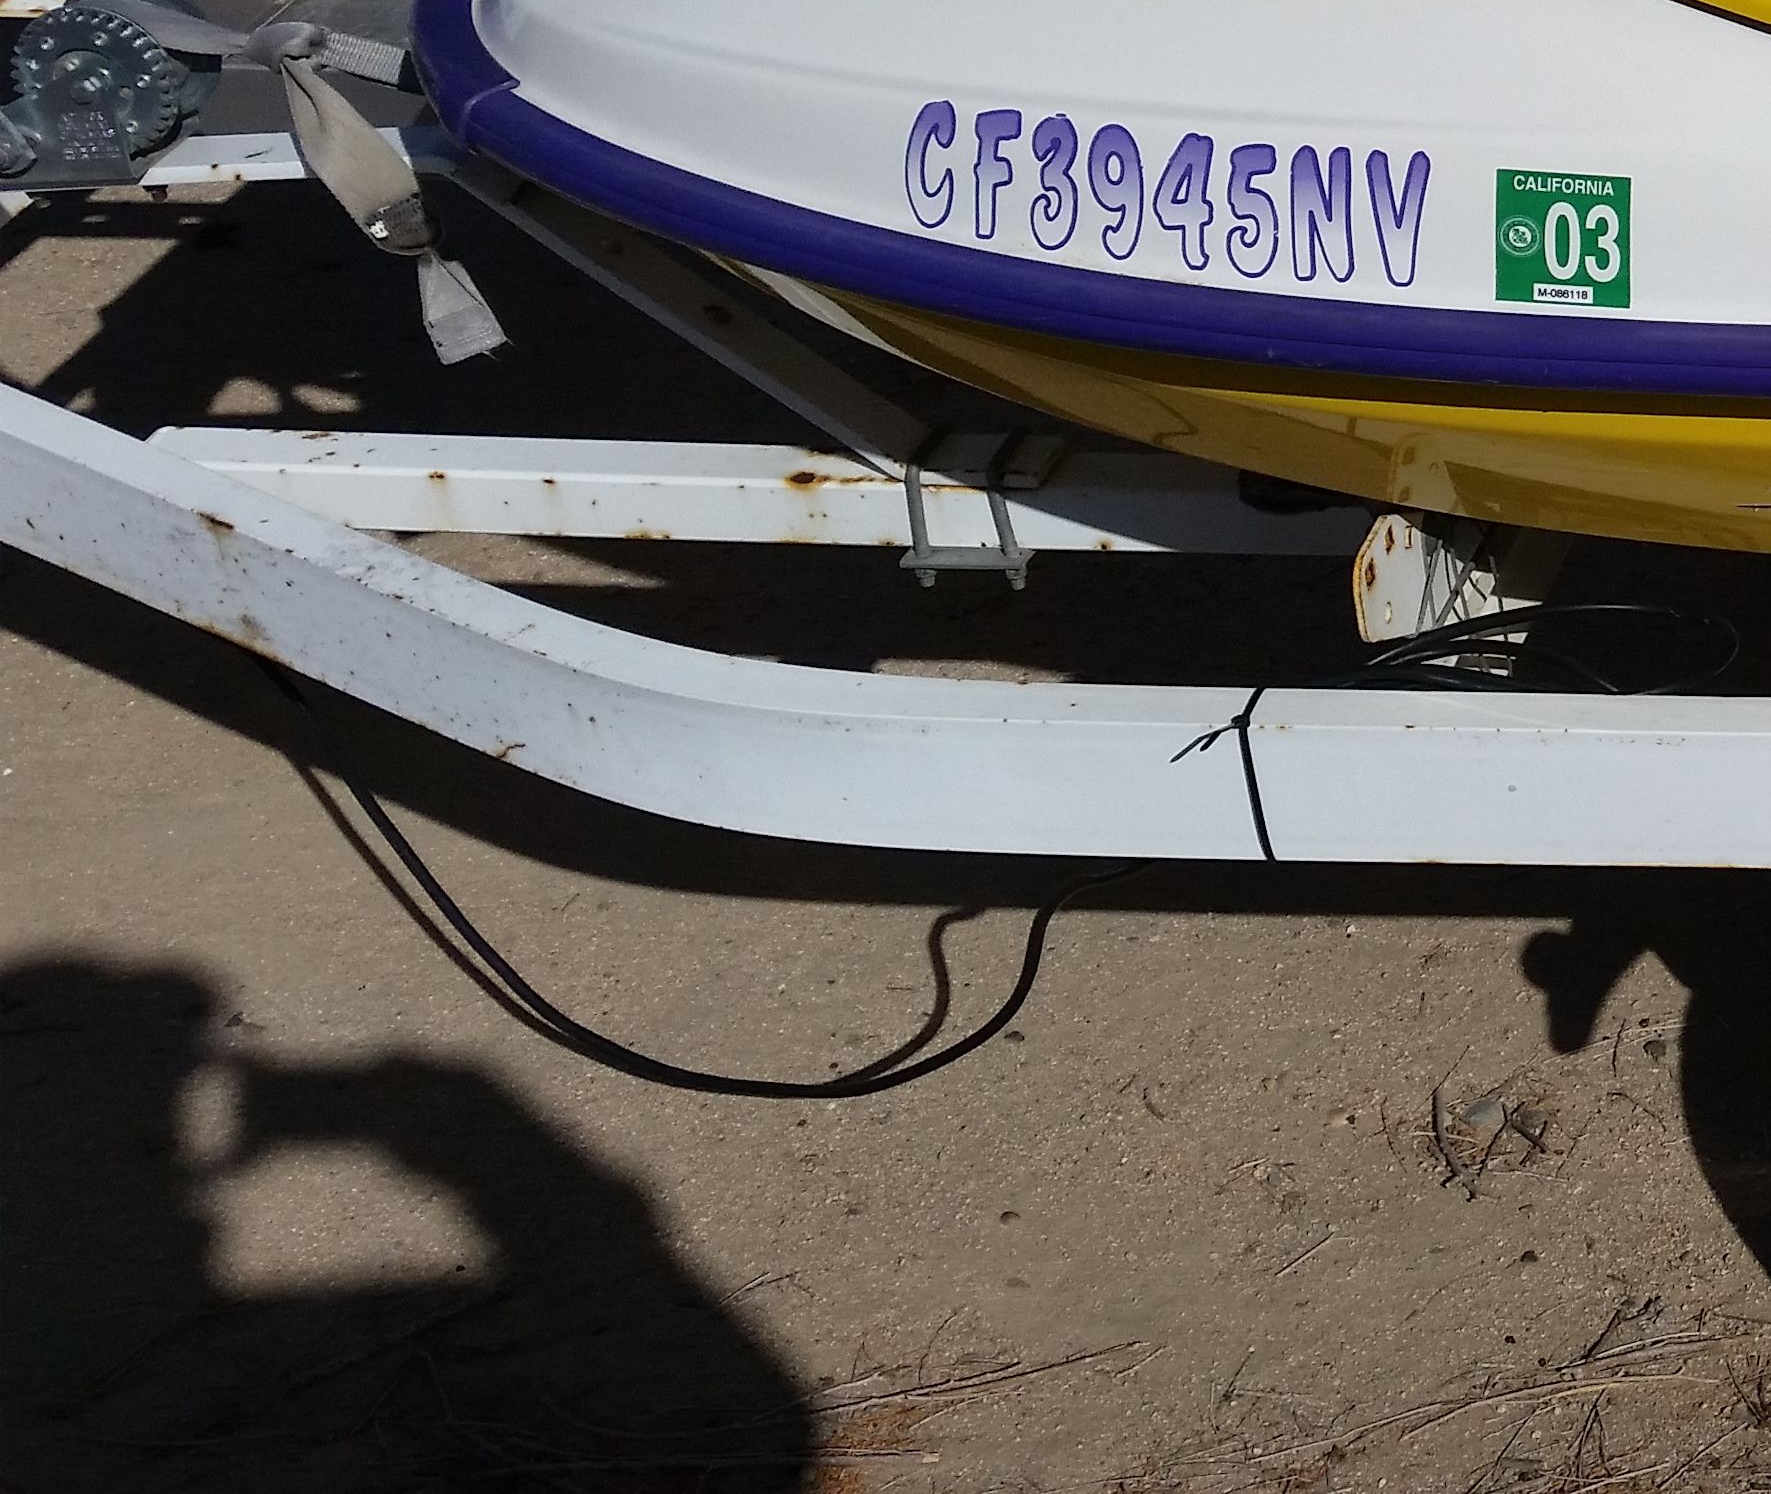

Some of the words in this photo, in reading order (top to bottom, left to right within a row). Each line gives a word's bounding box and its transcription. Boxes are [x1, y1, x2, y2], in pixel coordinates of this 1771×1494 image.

[905, 100, 1431, 287] CF3945NV
[1513, 175, 1614, 196] CALIFORNIA
[1544, 201, 1621, 283] 03
